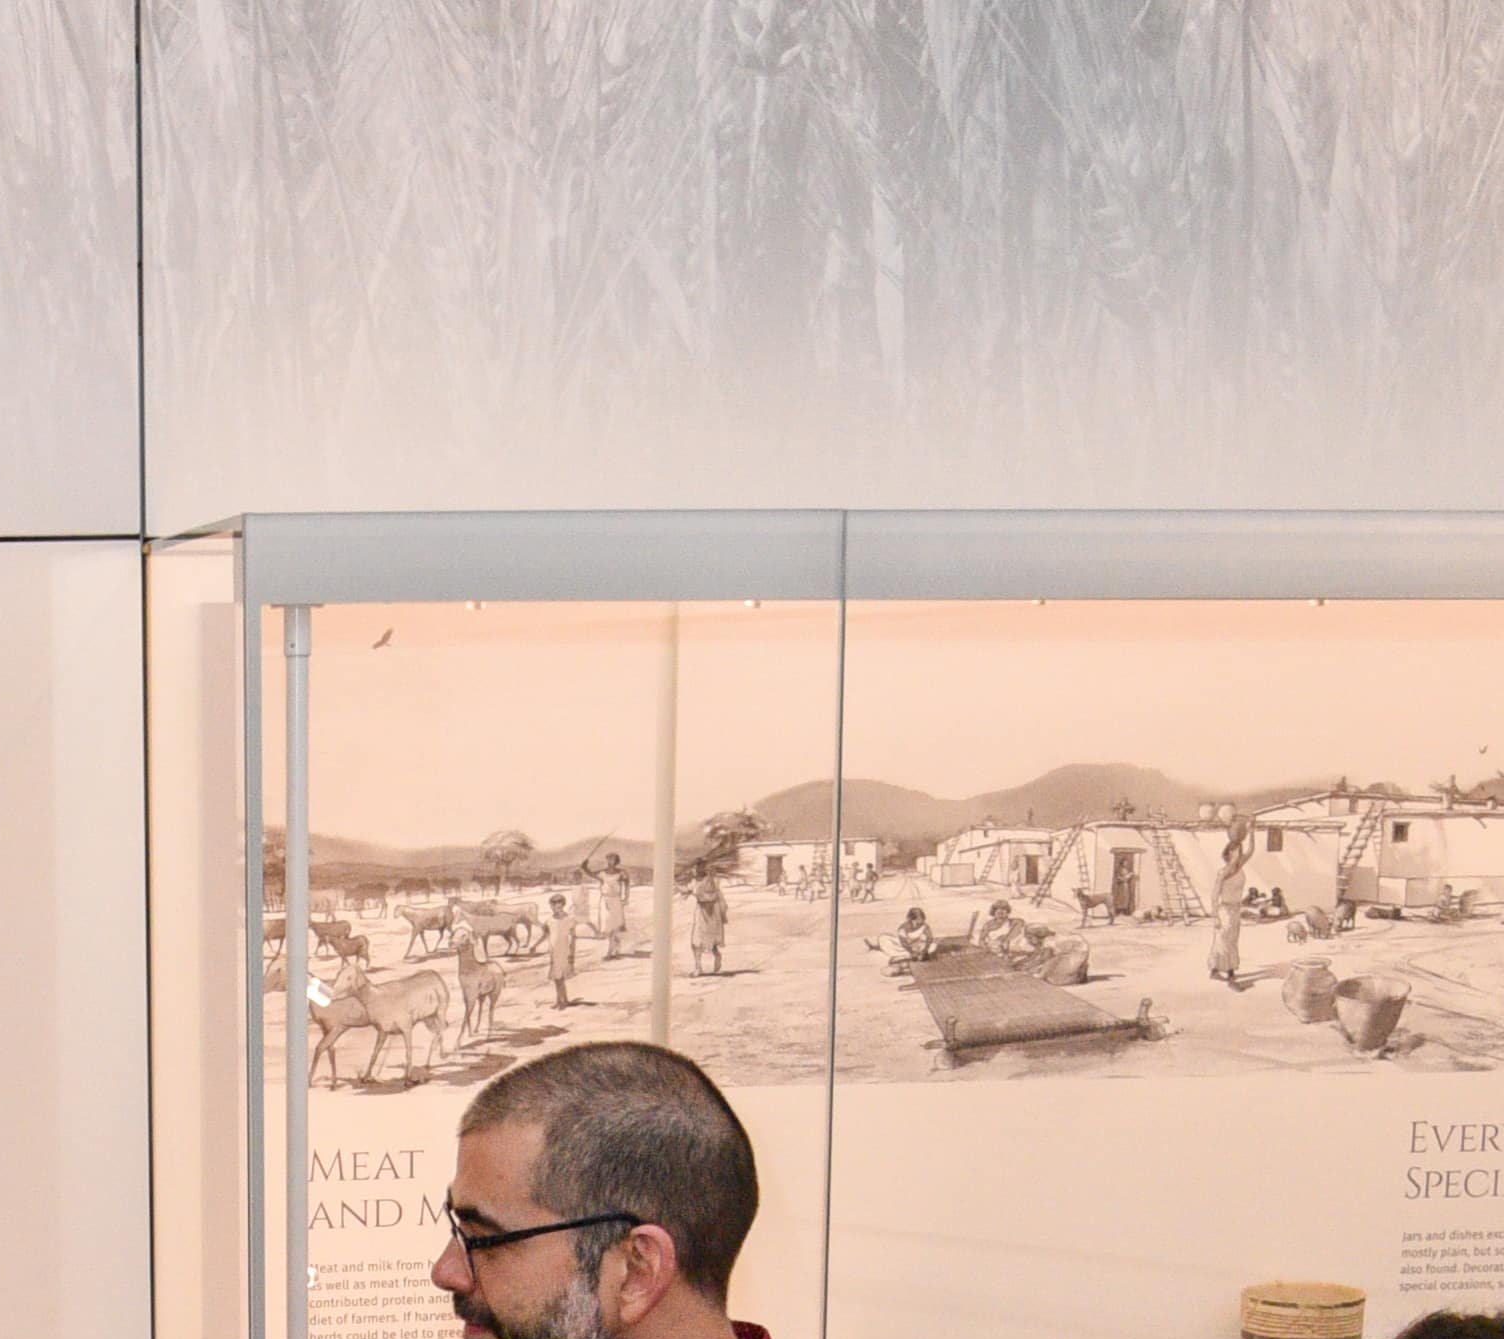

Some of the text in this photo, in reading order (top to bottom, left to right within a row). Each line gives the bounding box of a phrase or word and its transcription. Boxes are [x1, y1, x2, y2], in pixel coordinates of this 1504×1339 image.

[309, 1148, 424, 1182] MEAT
[309, 1199, 402, 1230] AND
[1402, 1232, 1422, 1242] Jars
[1425, 1230, 1445, 1241] and
[1449, 1230, 1483, 1240] dishes
[1401, 1247, 1437, 1259] mostly
[1440, 1247, 1469, 1259] plain,
[1473, 1246, 1490, 1256] but
[309, 1294, 449, 1308] contributed protein and
[309, 1312, 412, 1325] diet of farmers. If
